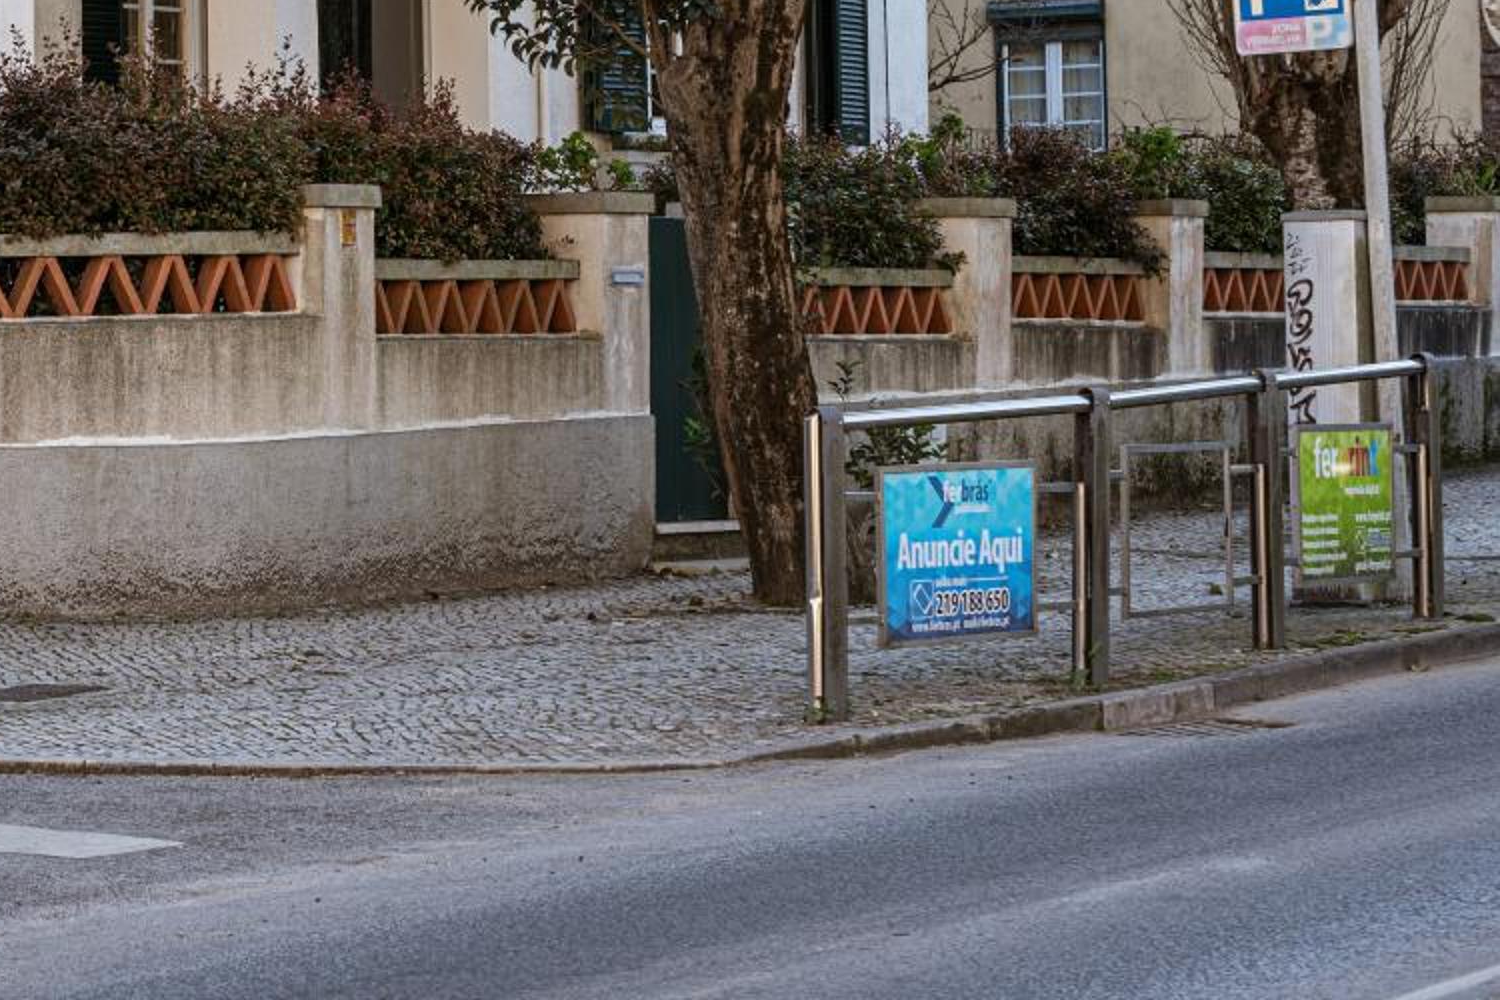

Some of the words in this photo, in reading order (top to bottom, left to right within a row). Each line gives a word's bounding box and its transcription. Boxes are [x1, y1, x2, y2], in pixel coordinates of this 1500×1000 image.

[897, 529, 975, 571] Anuncie
[979, 526, 1023, 574] Aqui
[936, 592, 959, 616] 219
[986, 587, 1010, 613] 650
